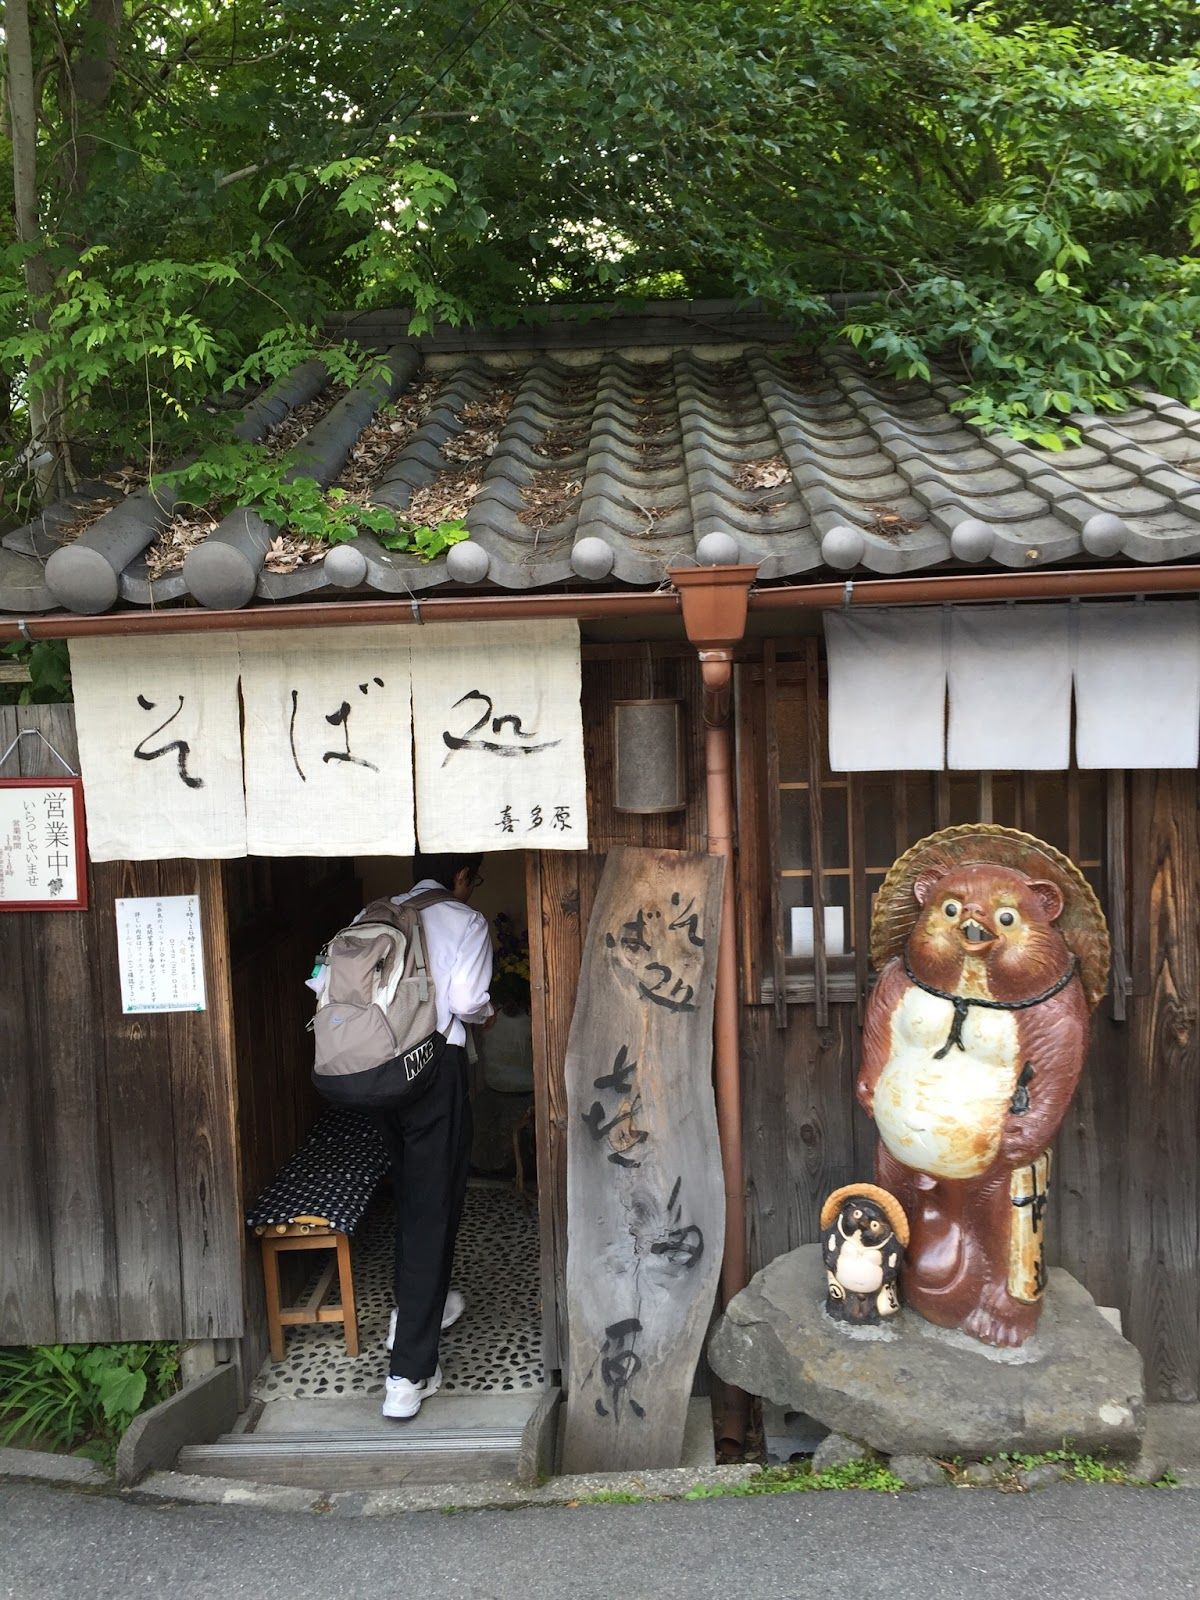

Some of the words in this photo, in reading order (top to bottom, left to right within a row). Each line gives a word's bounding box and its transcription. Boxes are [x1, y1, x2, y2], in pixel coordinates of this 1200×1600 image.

[12, 819, 22, 850] 営業時間
[43, 791, 69, 877] 営業中
[494, 804, 573, 834] 喜多原
[403, 1040, 434, 1081] NIKE
